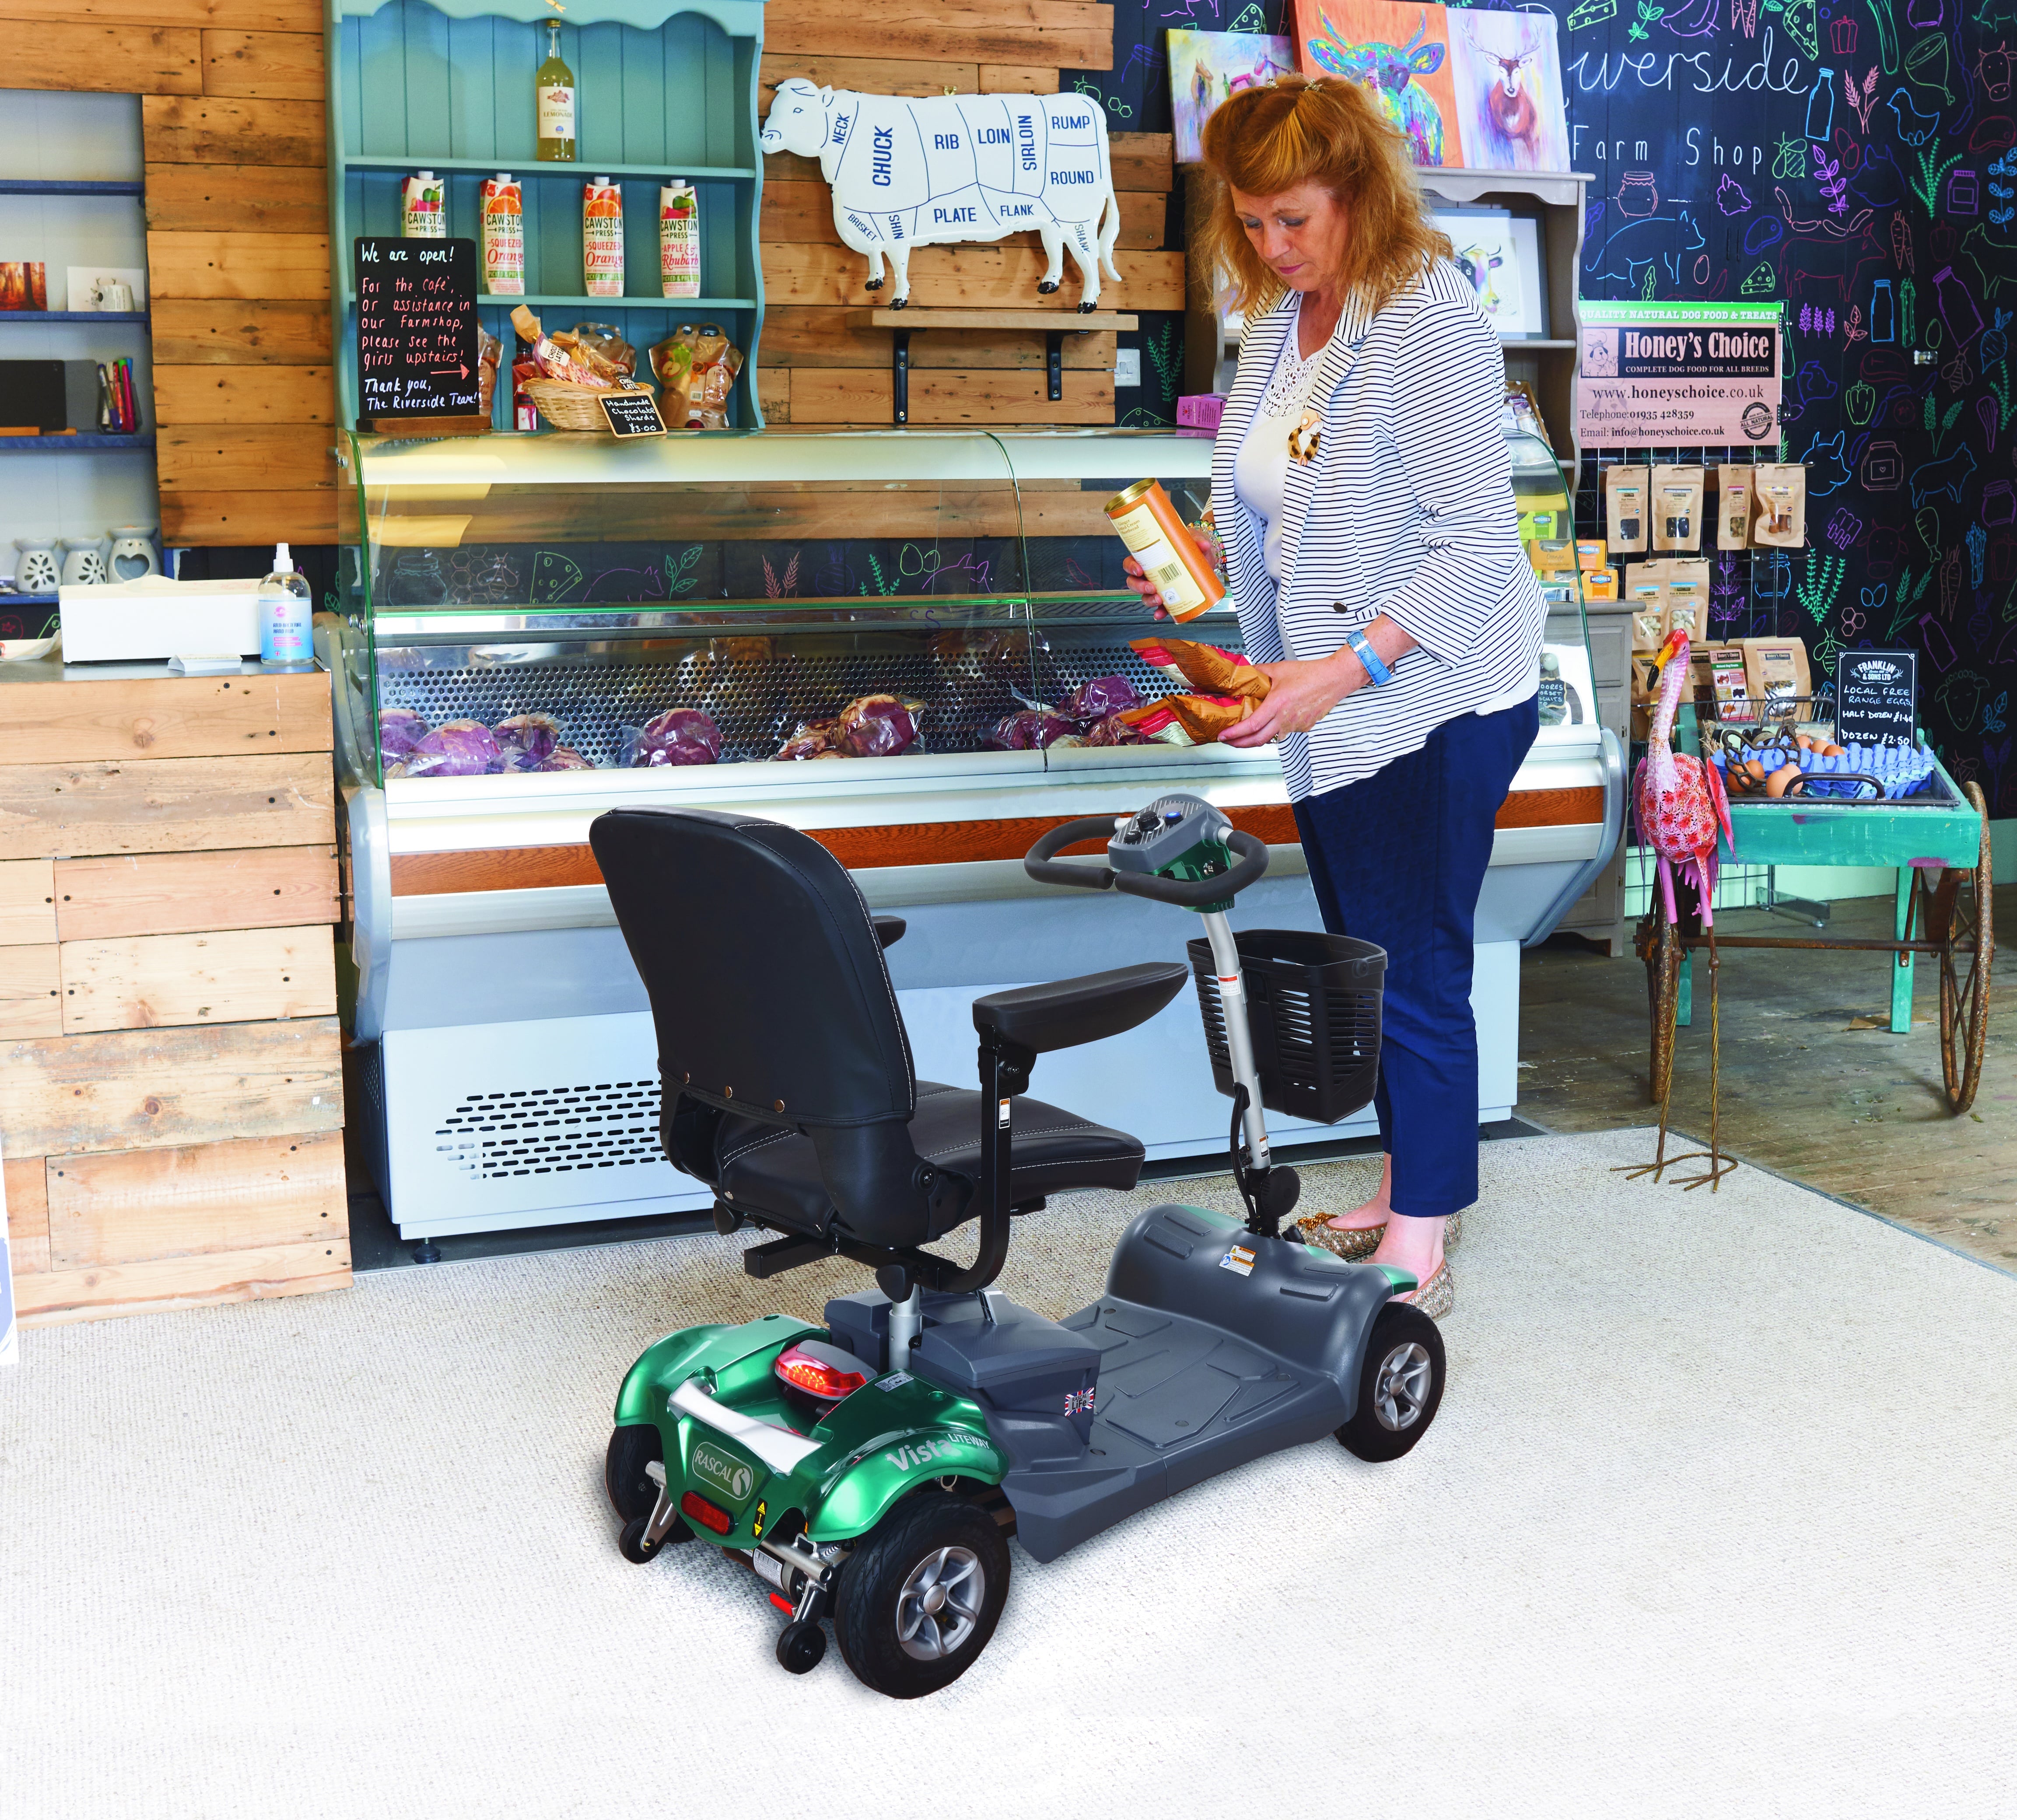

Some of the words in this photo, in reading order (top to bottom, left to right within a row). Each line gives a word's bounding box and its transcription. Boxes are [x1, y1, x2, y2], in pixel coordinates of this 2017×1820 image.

[1567, 26, 1808, 94] iverside
[833, 113, 850, 145] NECK
[1052, 116, 1090, 130] RUMP
[935, 134, 959, 150] RIB
[978, 128, 1010, 144] LOIN
[1018, 115, 1037, 171] SIRLOIN
[872, 126, 893, 186] CHUCK
[1573, 125, 1648, 161] Farm
[1686, 128, 1762, 175] Shop
[1051, 171, 1094, 185] ROUND
[408, 213, 445, 224] CAWSTON
[934, 207, 977, 224] PLATE
[1000, 204, 1034, 217] FLANK
[487, 215, 523, 225] CAWSTON
[585, 218, 622, 228] CAWSTON
[661, 220, 697, 231] CAWSTON
[847, 214, 879, 242] BRISKET
[889, 214, 903, 240] SHIN
[491, 238, 522, 247] SQUEEZED
[1074, 224, 1091, 253] SHANK
[362, 242, 380, 262] We
[389, 251, 408, 261] are
[420, 246, 454, 265] open!
[488, 249, 523, 265] Orange
[685, 244, 695, 256] &
[586, 252, 623, 267] Orange
[662, 254, 698, 270] Rhubarb
[362, 277, 380, 294] For
[396, 277, 413, 292] the
[394, 295, 453, 312] assistance
[459, 295, 470, 311] in
[1580, 310, 1626, 320] QUALITY
[1629, 311, 1679, 319] NATURAL
[1682, 311, 1701, 320] DOG
[1703, 311, 1728, 320] FOOD
[1730, 312, 1737, 320] &
[1740, 312, 1777, 320] TREATS
[362, 336, 399, 350] please
[409, 337, 427, 347] see
[438, 335, 455, 347] the
[1625, 332, 1702, 361] Honey's
[1708, 332, 1769, 358] Choice
[364, 351, 393, 371] girls
[406, 350, 463, 366] upstairs!
[364, 378, 402, 393] Thank
[407, 379, 431, 397] you,
[1593, 385, 1764, 401] www.honeyschoice.co.uk
[367, 397, 388, 410] The
[393, 394, 445, 409] Riverside
[449, 392, 477, 406] Team!
[1660, 410, 1694, 420] 428359
[1751, 414, 1773, 424] NATURAL
[1580, 428, 1609, 437] Email:
[1611, 426, 1725, 438] info@honeyschoice.co.uk
[1857, 660, 1896, 674] FRANKLIN
[1844, 685, 1877, 694] LOCAL
[1883, 687, 1909, 696] FREE
[1849, 696, 1881, 704] RANGE
[1887, 698, 1912, 706] EGGS.
[1841, 729, 1877, 740] DOZEN
[1881, 733, 1910, 745] £2.50
[885, 1439, 952, 1471] Vista
[695, 1450, 732, 1483] RASCAL
